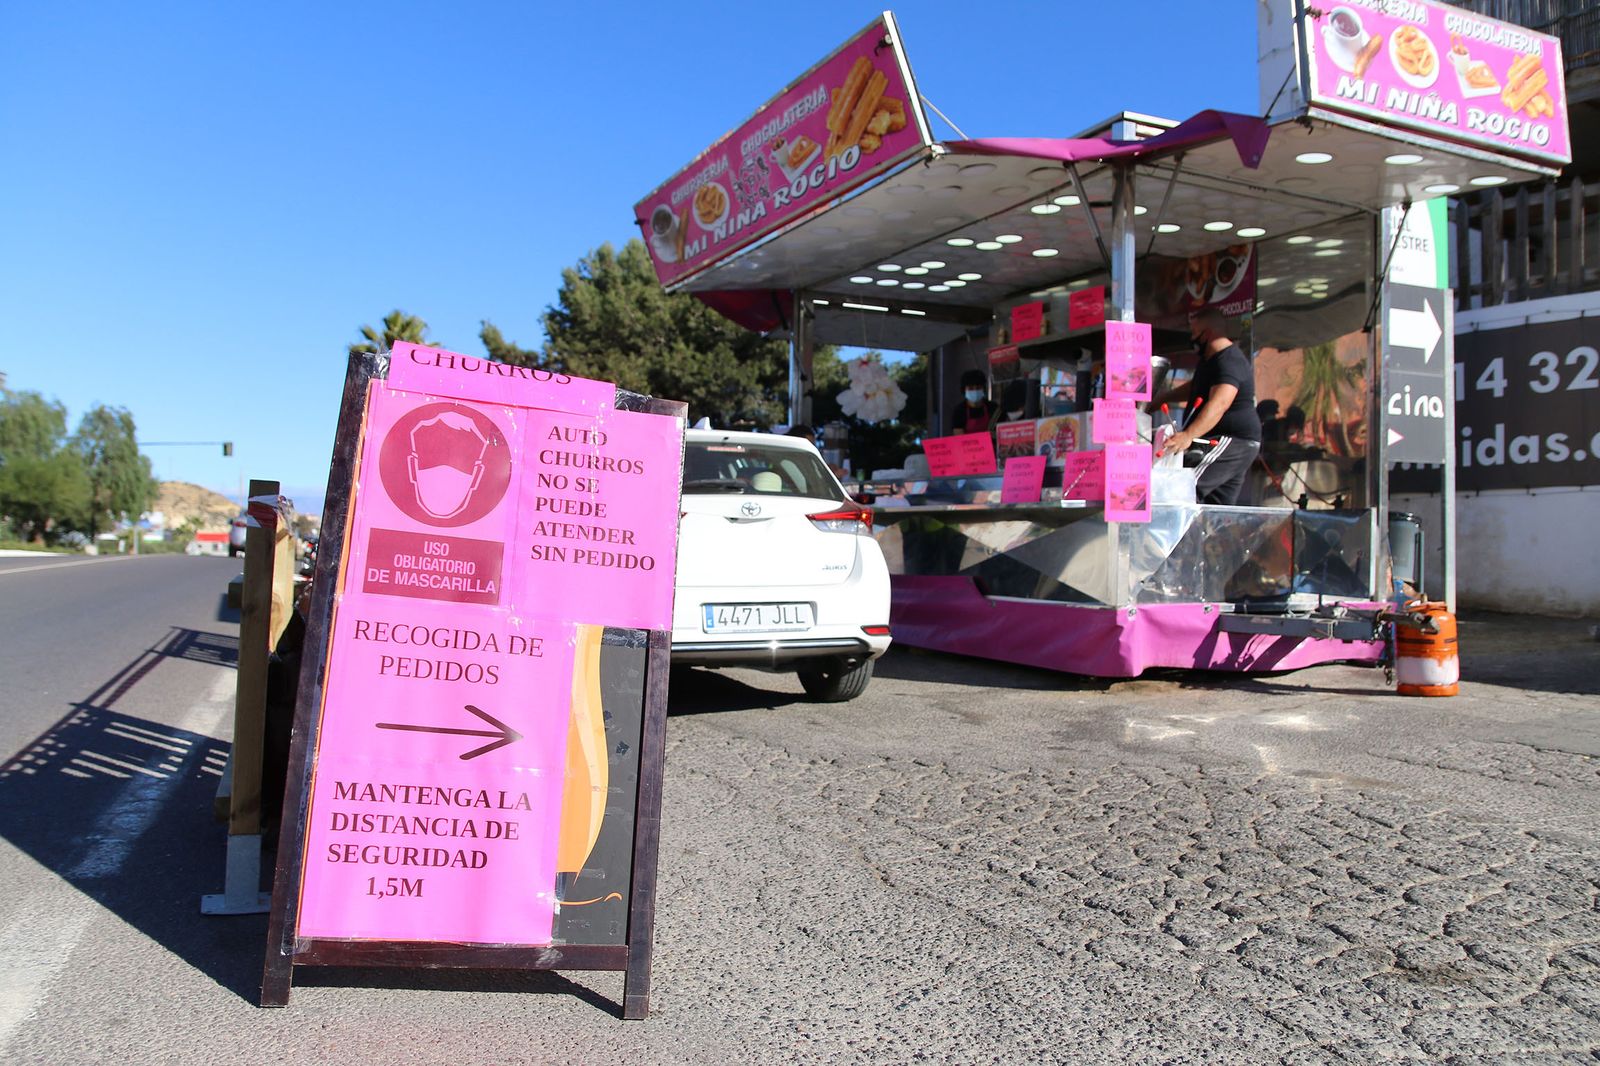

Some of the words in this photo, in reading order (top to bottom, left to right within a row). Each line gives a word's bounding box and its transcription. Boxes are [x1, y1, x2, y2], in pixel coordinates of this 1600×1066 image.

[1446, 13, 1543, 55] CHOCOLATERIA
[741, 85, 828, 155] CHOCOLATERIA
[1336, 75, 1379, 104] MI
[1387, 87, 1459, 125] NIÑA
[1467, 108, 1550, 146] ROCIO
[671, 154, 729, 205] CHURRERIA
[684, 239, 707, 260] MI
[773, 144, 861, 209] ROCIO
[1528, 346, 1600, 394] 32
[547, 425, 608, 447] AUTO
[538, 448, 644, 476] CHURROS
[536, 472, 568, 491] NO
[574, 475, 600, 494] SE
[534, 496, 607, 518] PUEDE
[532, 520, 635, 545] ATENDER
[424, 540, 450, 557] USO
[531, 544, 567, 564] SIN
[573, 548, 655, 571] PEDIDO
[393, 553, 476, 576] OBLIGATORIO
[367, 567, 390, 585] DE
[394, 570, 496, 594] MASCARILLA
[718, 606, 762, 626] 4471
[772, 604, 805, 625] JLL
[353, 619, 502, 654] RECOGIDA
[508, 634, 544, 658] DE
[378, 655, 500, 685] PEDIDOS
[332, 781, 492, 810] MANTENGA
[497, 789, 533, 812] LA
[330, 812, 478, 839] DISTANCIA
[484, 819, 520, 841] DE
[326, 843, 488, 870] SEGURIDAD
[365, 876, 424, 900] 1,5M
